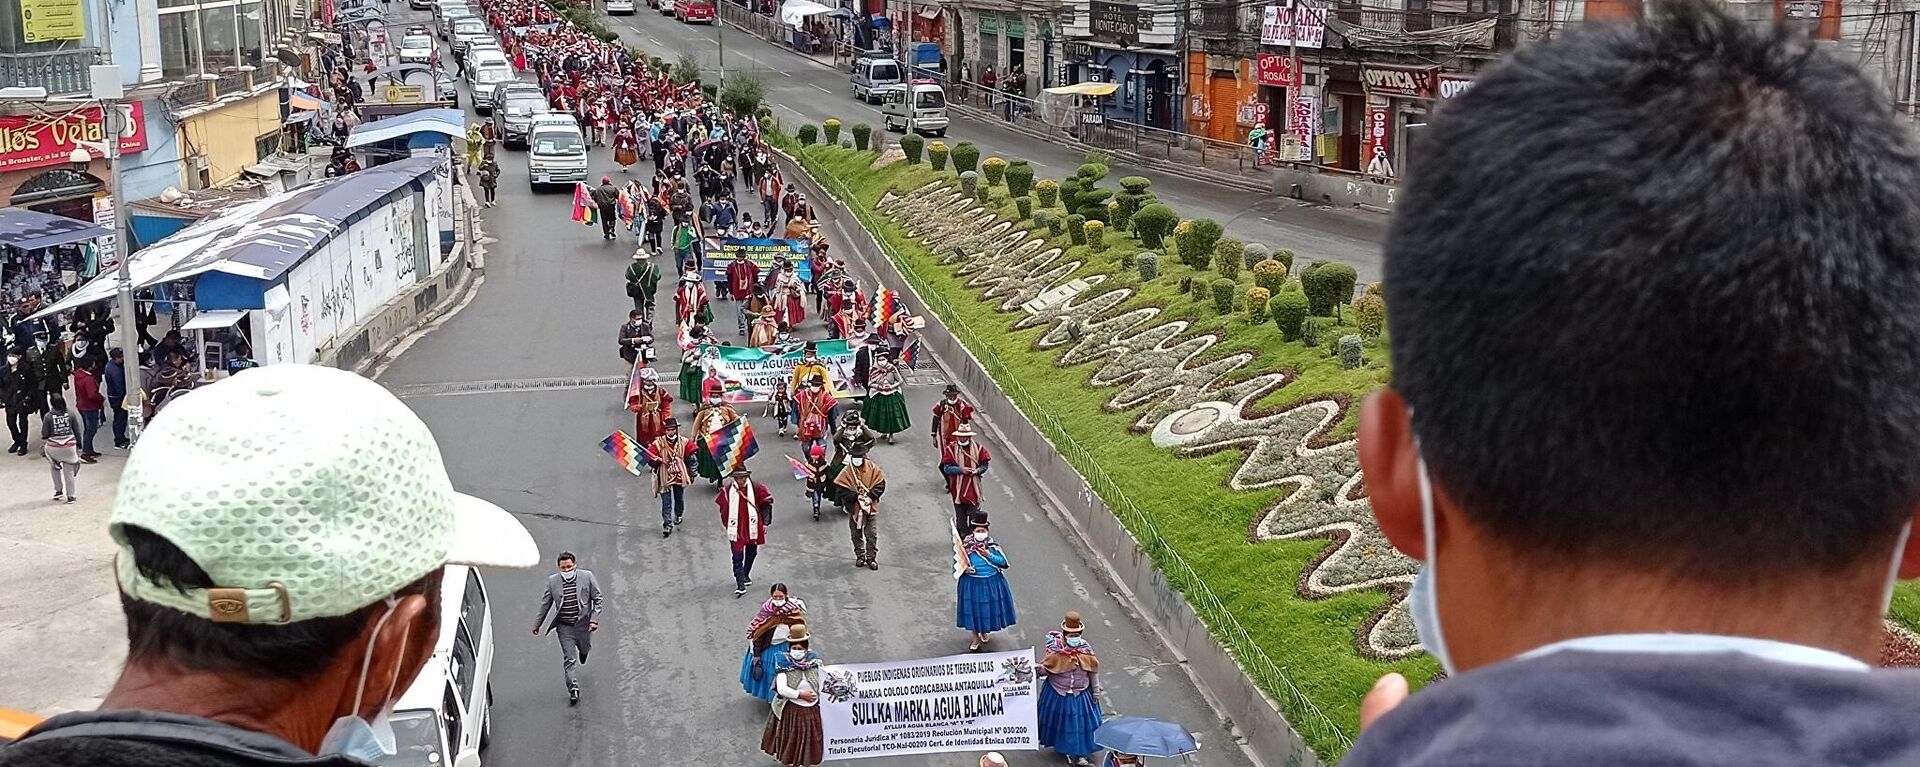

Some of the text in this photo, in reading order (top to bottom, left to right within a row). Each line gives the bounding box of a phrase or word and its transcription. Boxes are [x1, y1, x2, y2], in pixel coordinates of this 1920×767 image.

[1103, 12, 1126, 22] HOTEL
[1275, 7, 1324, 27] NOARIA
[1095, 19, 1114, 32] MONTE
[1115, 21, 1135, 34] CARLO
[1280, 24, 1306, 41] PUBICA
[1260, 56, 1298, 74] OPTIC
[1264, 71, 1298, 82] ROSALE
[1366, 69, 1417, 89] OPTICA
[1082, 114, 1103, 124] PARADA
[9, 155, 44, 166] Broaster,
[725, 355, 851, 370] AYLLU AGUA BCA "B"
[857, 660, 994, 683] PUEBLOS INDIGENAS ORIGINARIOS DE TIERRAS ALTAS
[859, 679, 995, 699] MARKA COLOLO COPACABANA ANTAQUILLA
[852, 692, 1004, 726] SULLKA MARKA AGUA BLANCA
[964, 727, 994, 736] Municipal
[848, 744, 880, 754] Ejecutorial
[954, 737, 984, 746] Identidad
[985, 736, 1004, 744] Étnica
[1006, 736, 1030, 744] 0027/02
